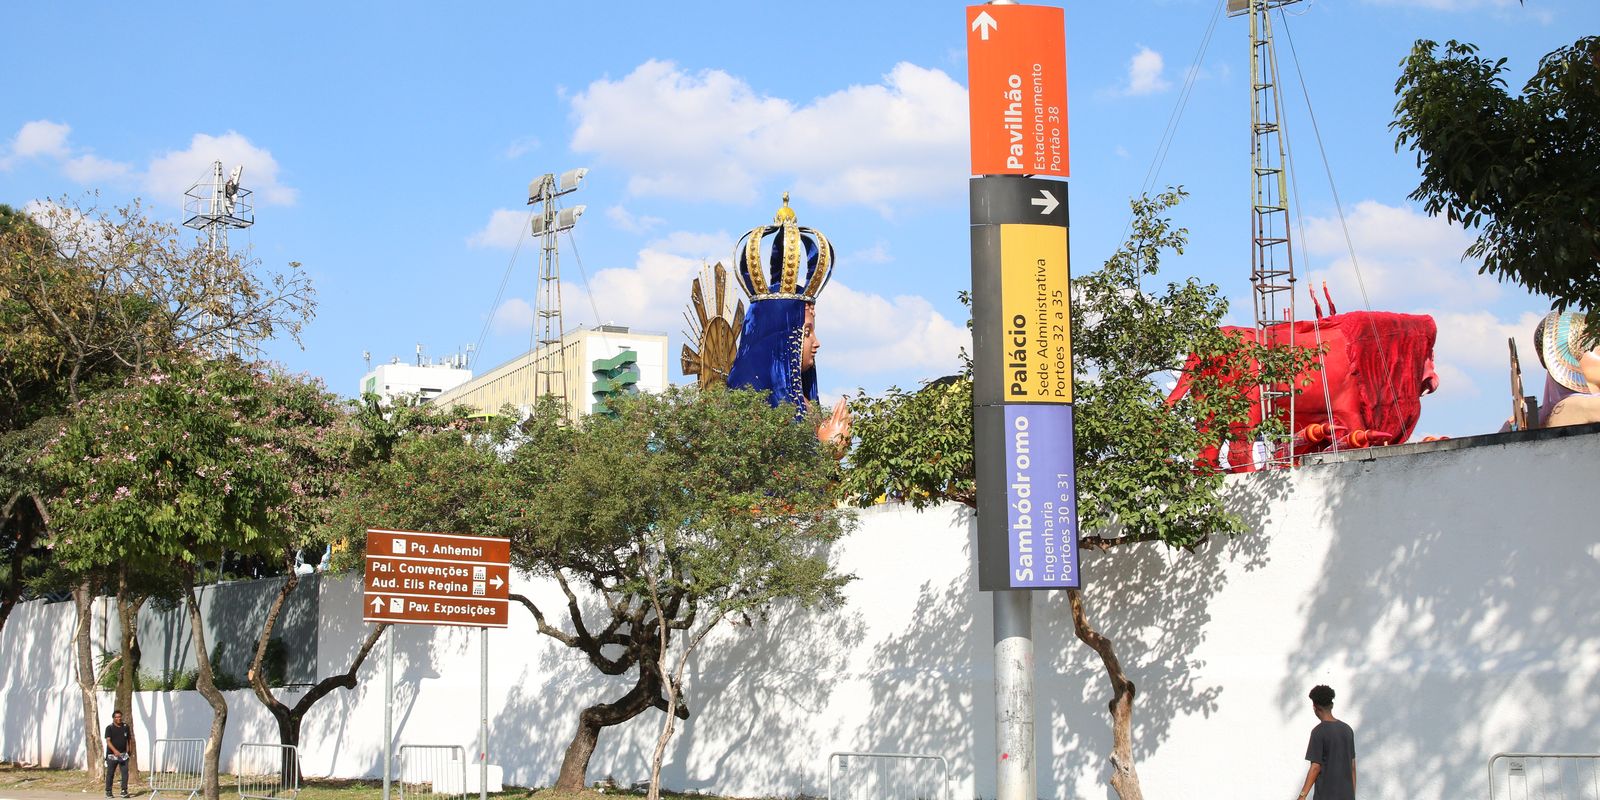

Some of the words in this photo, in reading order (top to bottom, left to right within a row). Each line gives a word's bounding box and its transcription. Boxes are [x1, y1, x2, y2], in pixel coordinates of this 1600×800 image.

[1004, 74, 1023, 169] Pavilhão
[1032, 63, 1045, 170] Estacionamento
[1048, 106, 1059, 124] 38
[1049, 128, 1061, 171] Portão
[1034, 258, 1049, 359] Administrativa
[1052, 290, 1063, 308] 35
[1055, 312, 1063, 320] a
[1053, 325, 1064, 342] 32
[1008, 314, 1028, 396] Palácio
[1037, 363, 1049, 396] Sede
[1054, 347, 1066, 397] Portões
[1057, 473, 1069, 489] 31
[1011, 415, 1033, 582] Sambódromo
[1060, 493, 1070, 502] e
[1059, 506, 1070, 525] 30
[411, 542, 429, 554] Pq.
[433, 544, 482, 557] Anhembi
[1041, 502, 1057, 582] Engenharia
[1060, 529, 1073, 582] Portões
[372, 561, 395, 573] Pal.
[399, 563, 469, 578] Convenções
[371, 577, 400, 588] Aud.
[404, 578, 425, 589] Elis
[429, 580, 468, 593] Regina
[409, 602, 430, 612] Pav.
[434, 603, 496, 617] Exposições
